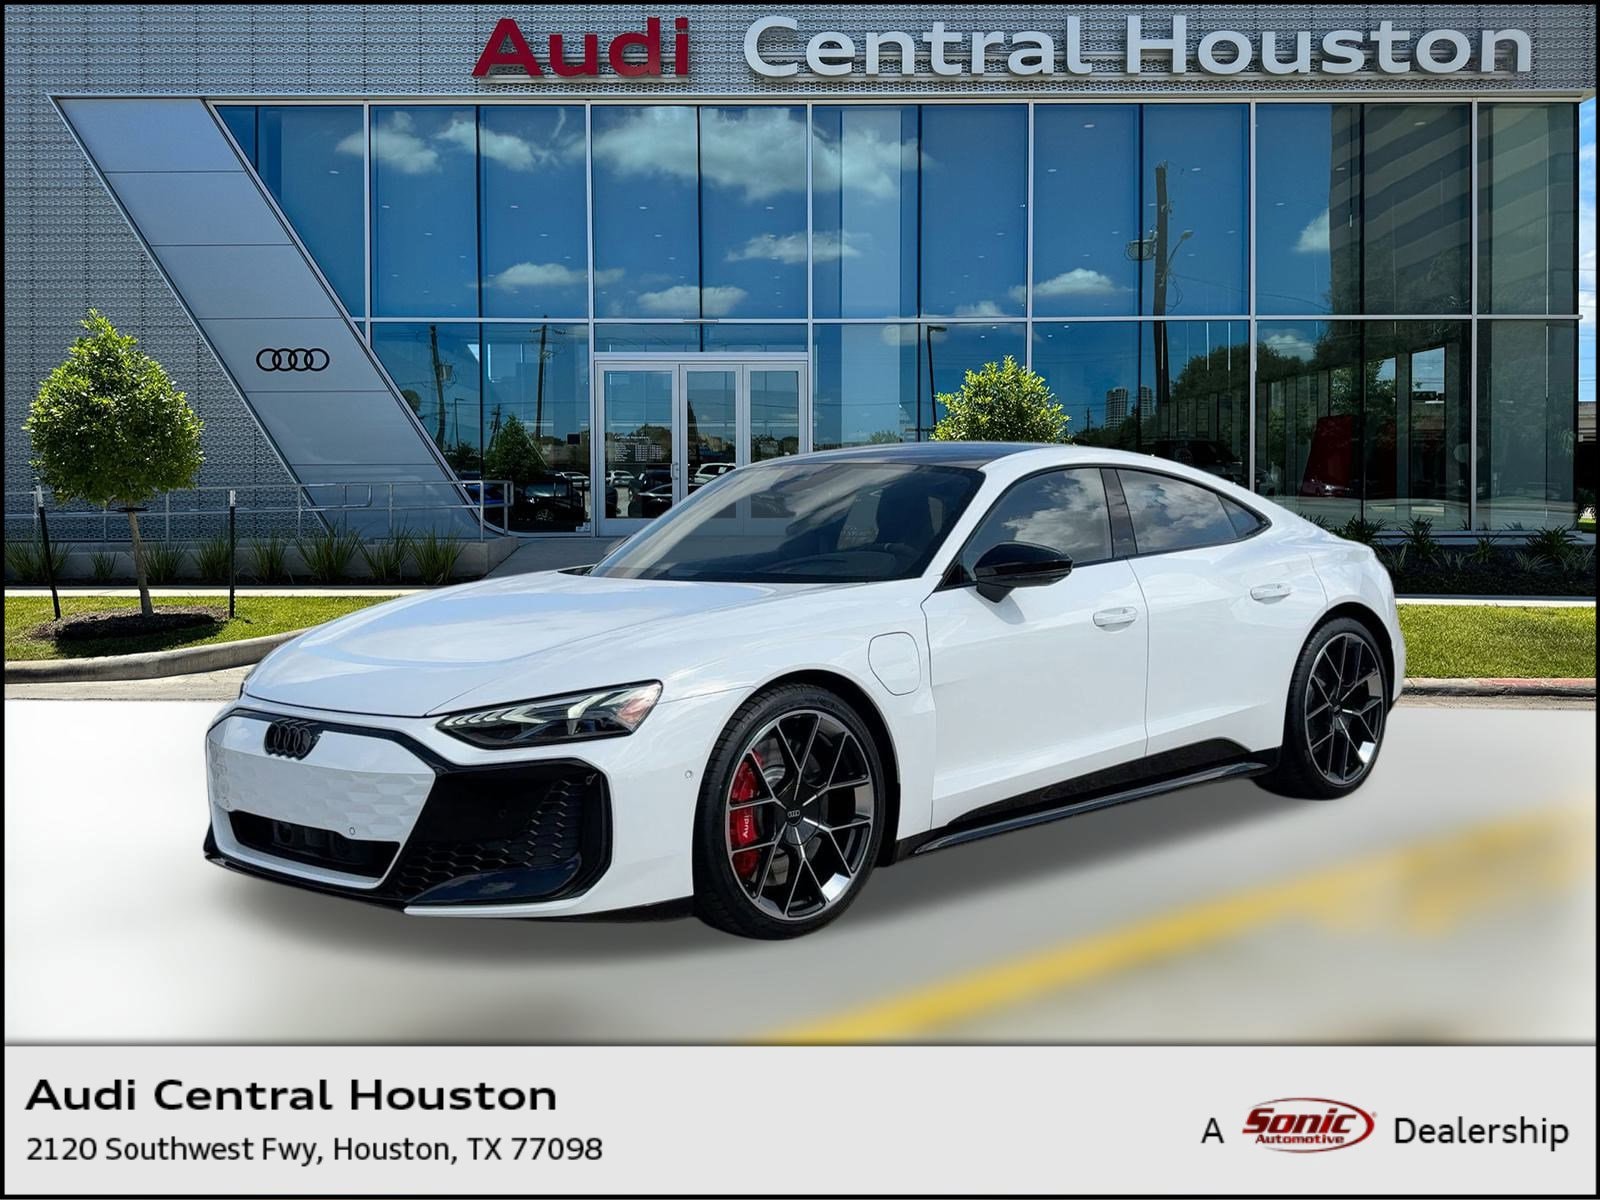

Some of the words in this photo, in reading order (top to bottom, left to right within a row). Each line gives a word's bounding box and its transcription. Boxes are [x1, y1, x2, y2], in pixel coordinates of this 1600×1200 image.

[473, 17, 691, 77] Audi
[743, 15, 1095, 77] Central
[1127, 14, 1533, 76] Houston
[742, 815, 750, 839] Audi
